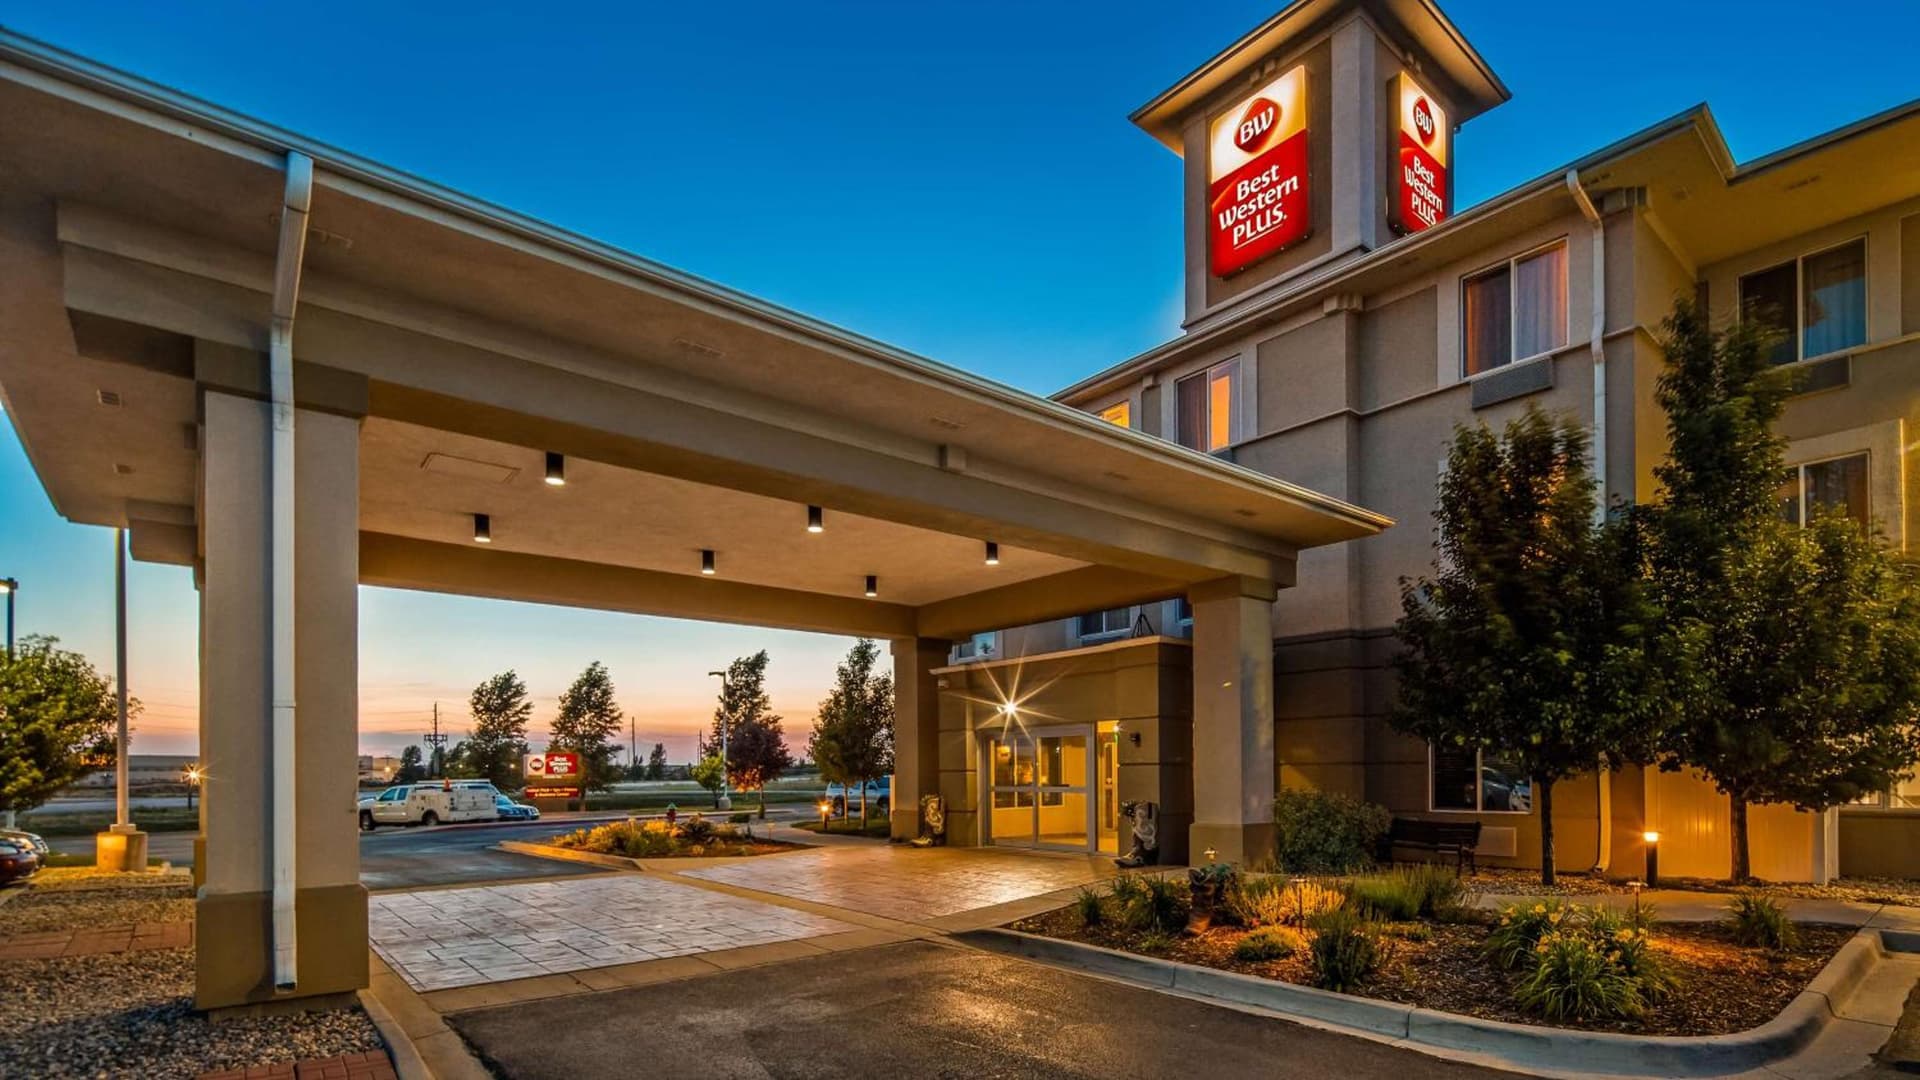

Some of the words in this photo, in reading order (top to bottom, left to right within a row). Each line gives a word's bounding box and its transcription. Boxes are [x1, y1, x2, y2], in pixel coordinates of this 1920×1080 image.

[1240, 106, 1274, 144] BW
[1415, 106, 1433, 135] BW
[1236, 164, 1280, 202] Best
[1404, 164, 1443, 213] Western
[1413, 155, 1436, 188] Best
[1218, 175, 1299, 231] Western
[1411, 192, 1437, 226] PLUS
